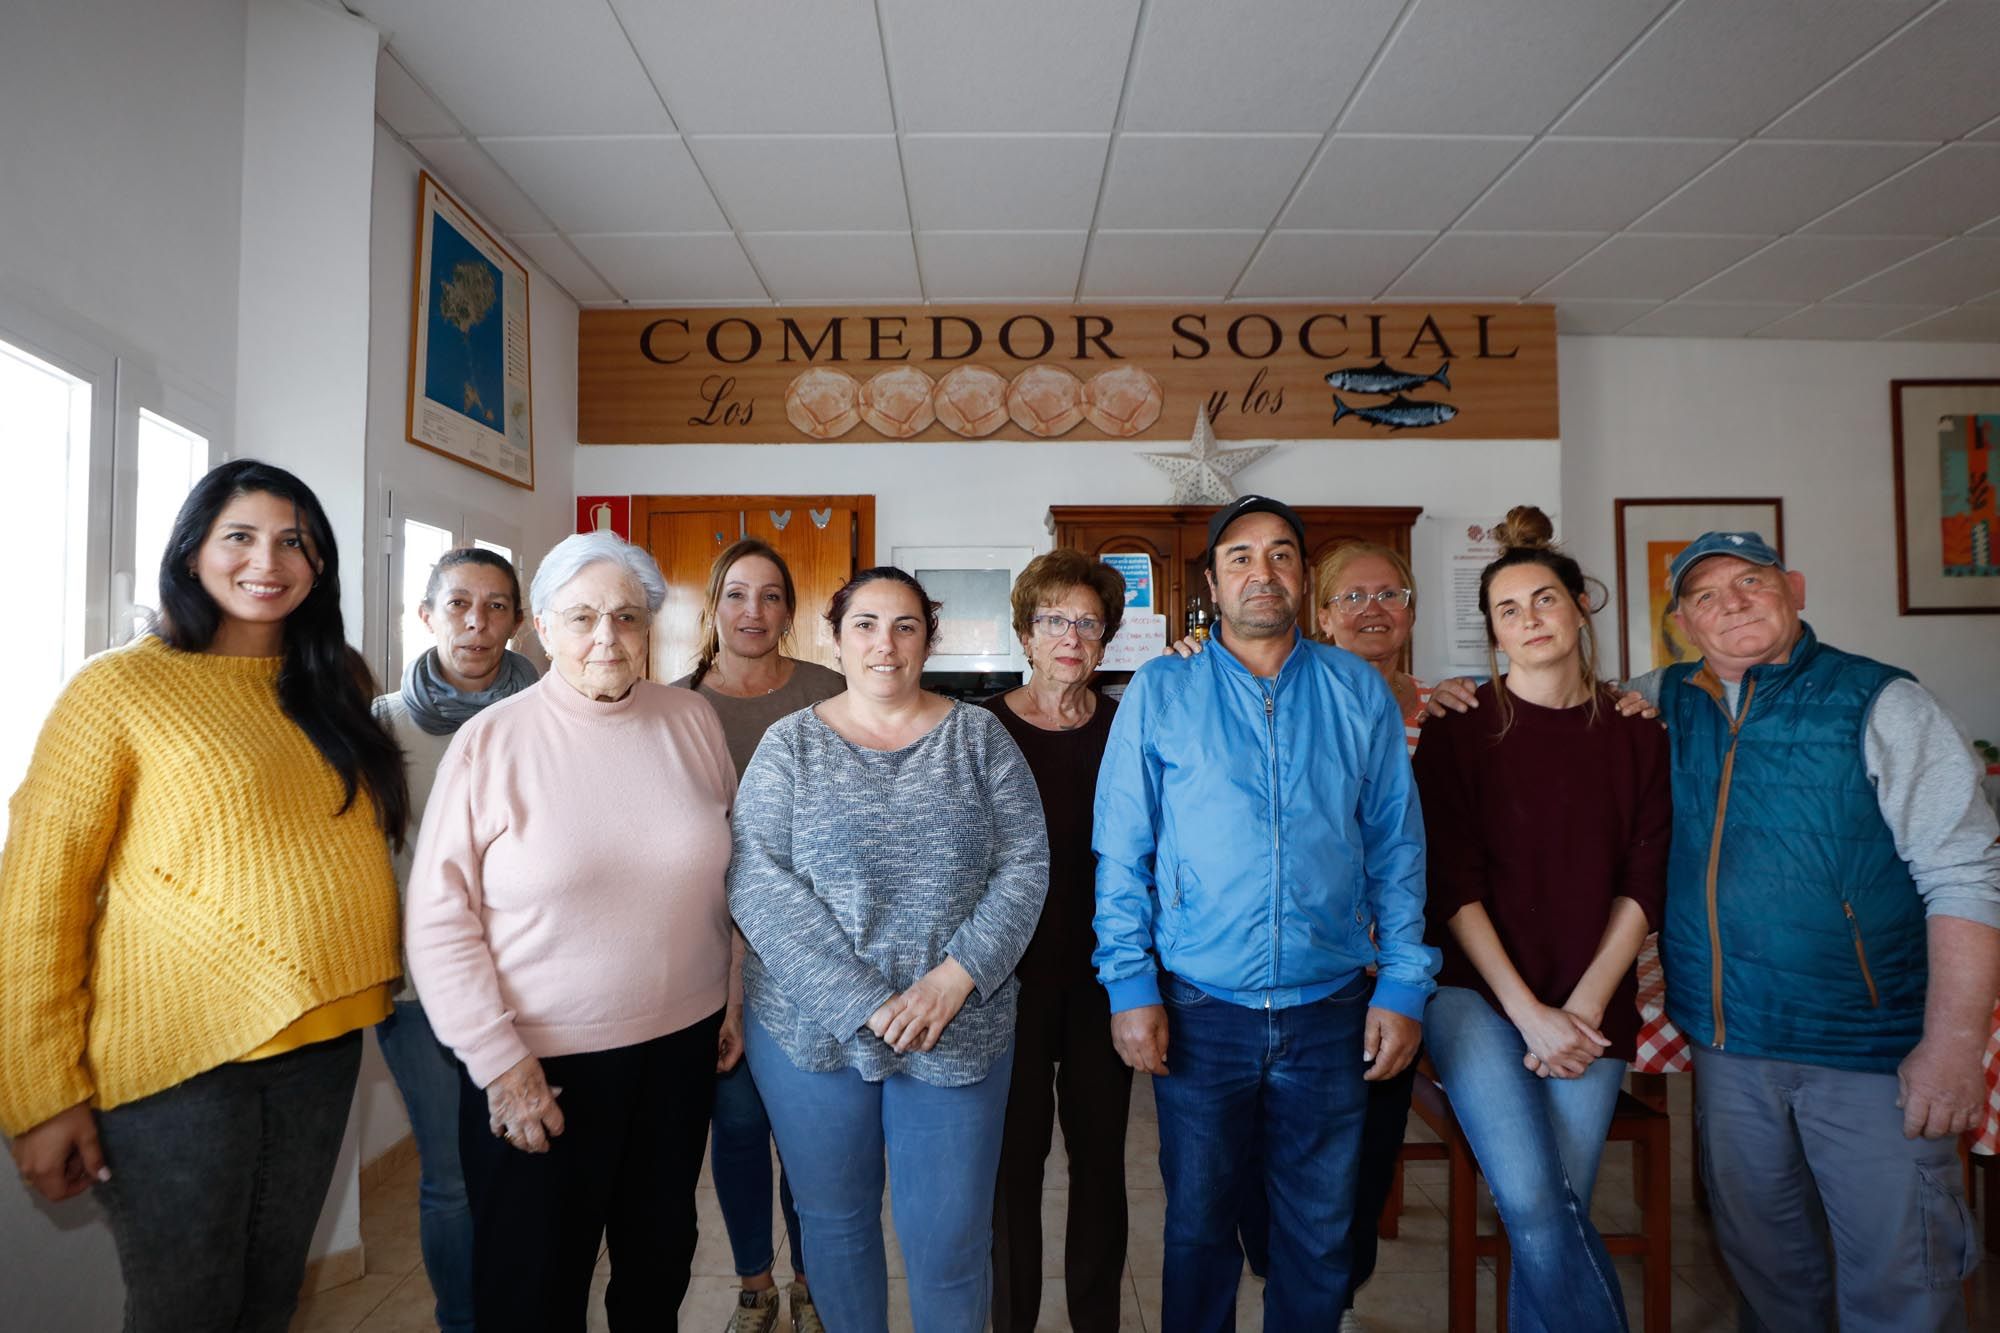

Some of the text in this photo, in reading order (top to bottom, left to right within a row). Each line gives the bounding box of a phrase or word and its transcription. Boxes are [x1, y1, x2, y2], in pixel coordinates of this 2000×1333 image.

[639, 313, 1519, 364] COMEDOR SOCIAL
[688, 366, 1285, 426] Los y los
